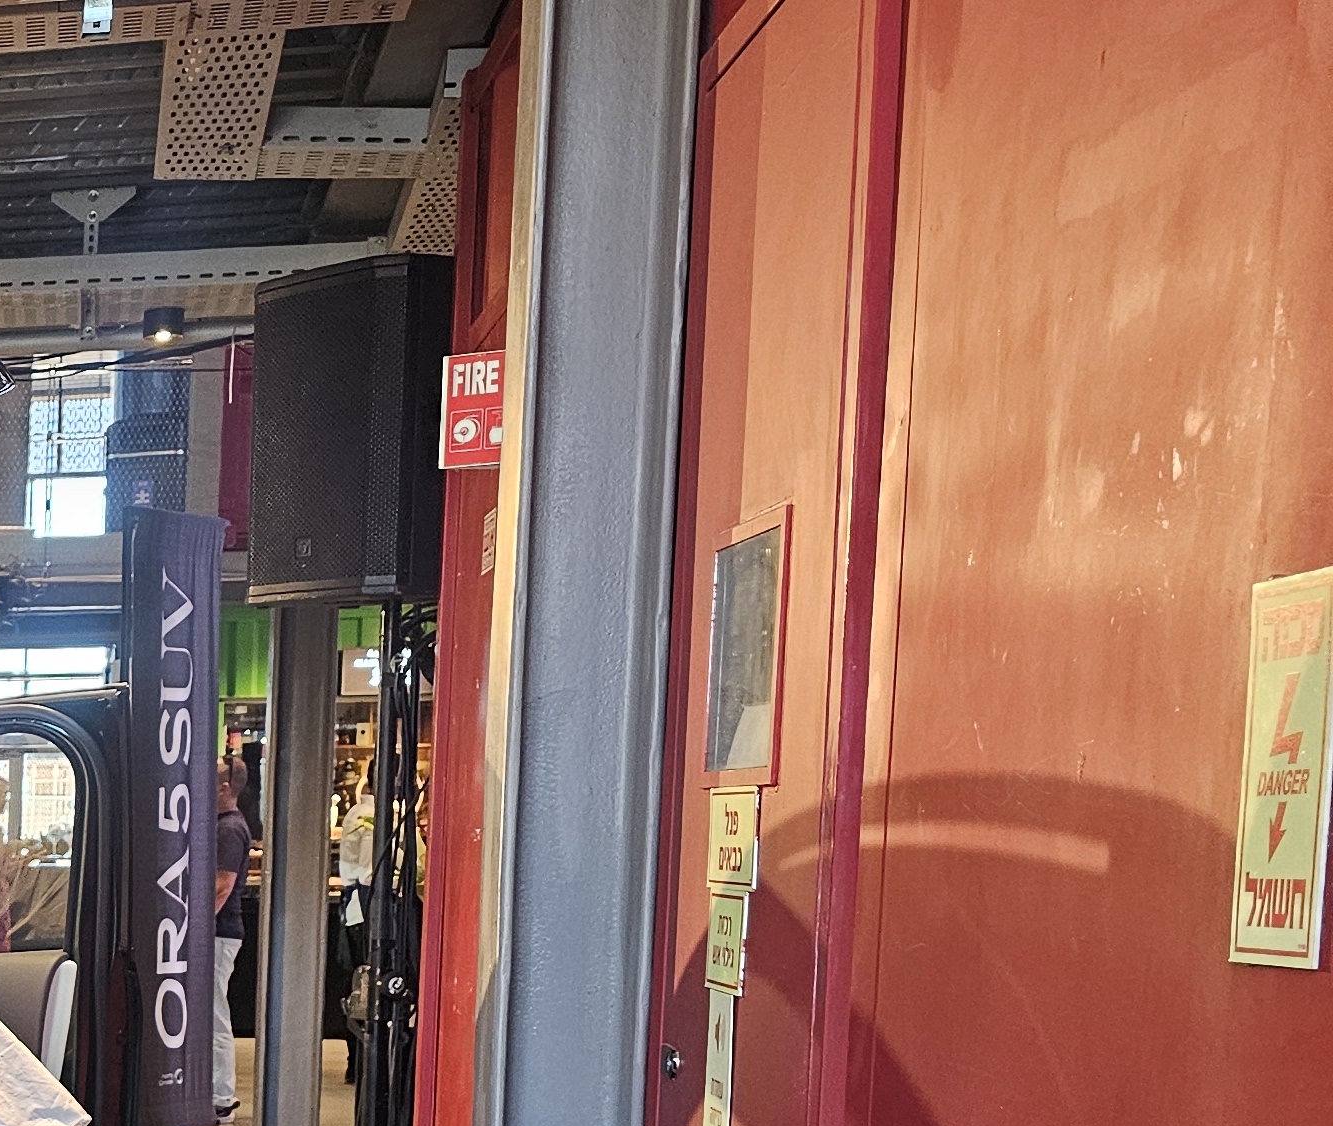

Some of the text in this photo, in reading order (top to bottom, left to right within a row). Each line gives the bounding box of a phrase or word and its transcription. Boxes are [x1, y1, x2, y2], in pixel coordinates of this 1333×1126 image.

[452, 359, 500, 398] FIRE
[1262, 598, 1326, 662] סכנה
[159, 565, 194, 766] SUV
[1256, 768, 1310, 797] DANGER
[158, 783, 191, 834] 5
[724, 803, 739, 836] פנל
[719, 846, 743, 872] כבאים
[1244, 872, 1307, 930] חשמל
[155, 846, 190, 1049] ORA
